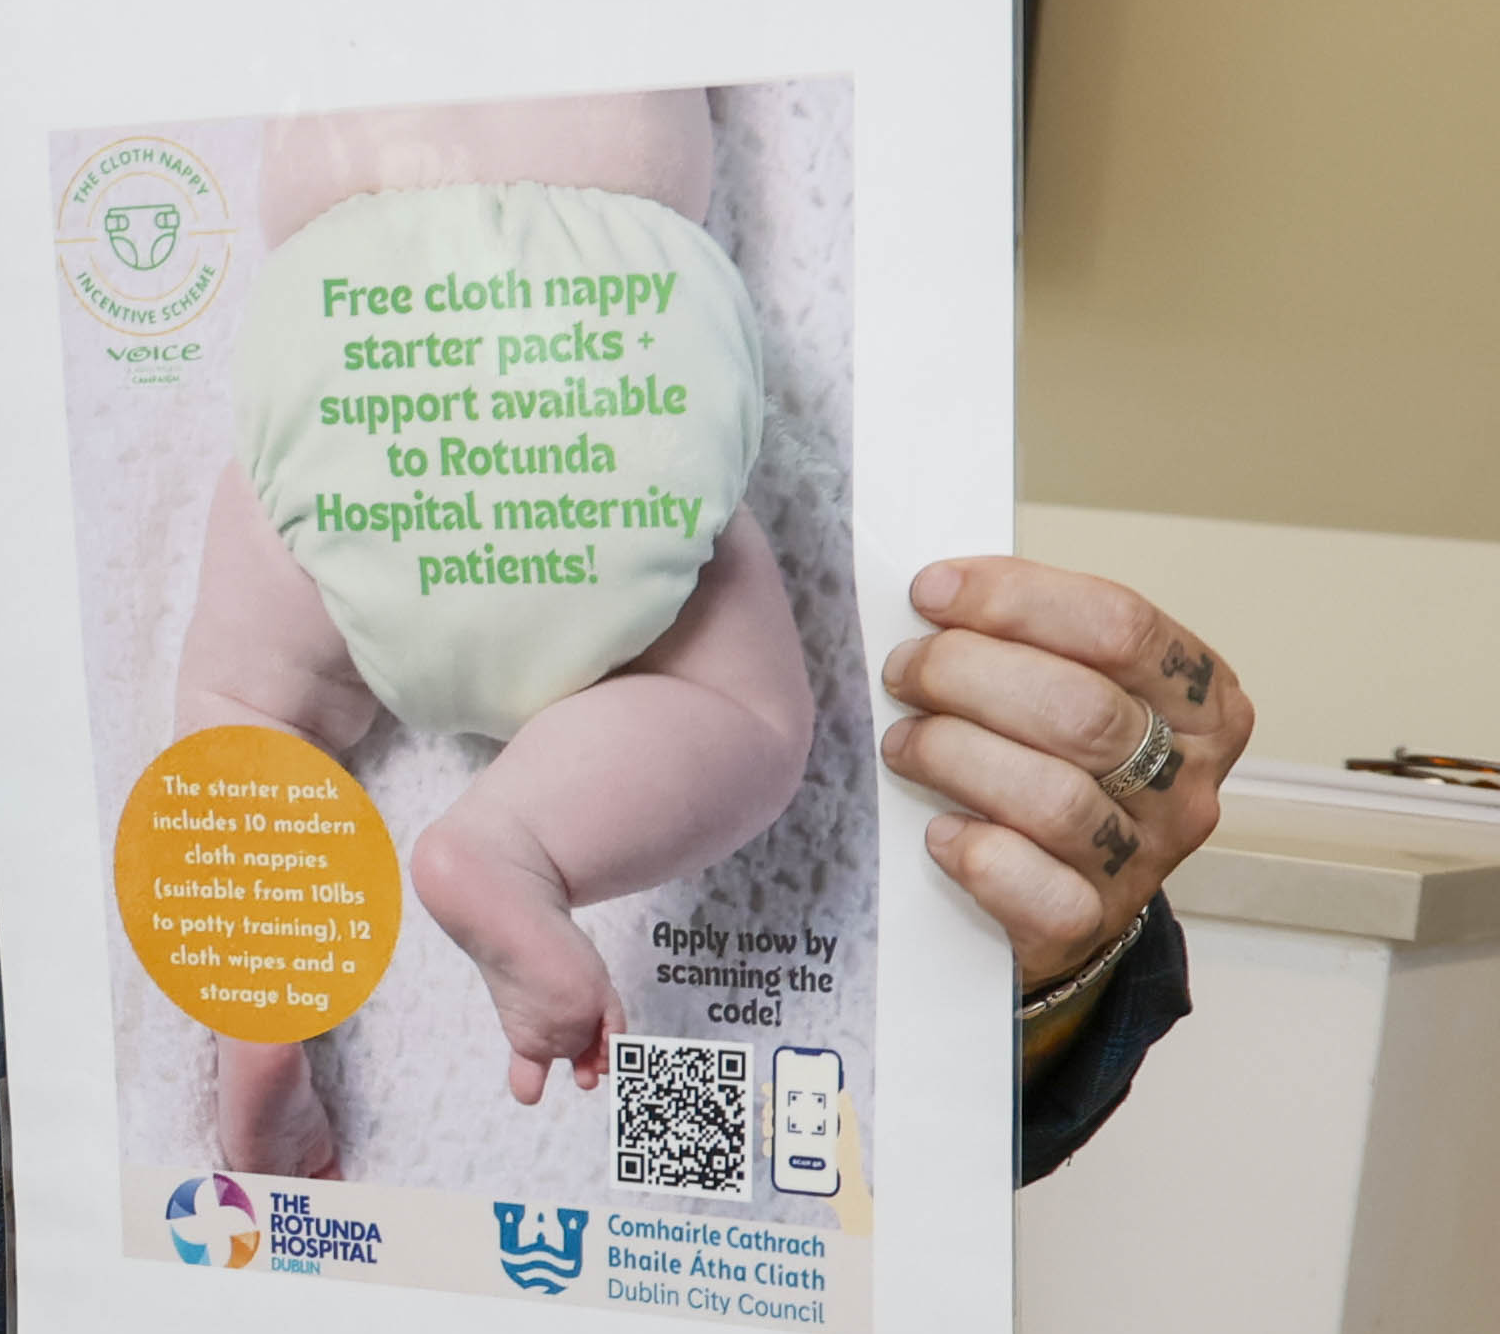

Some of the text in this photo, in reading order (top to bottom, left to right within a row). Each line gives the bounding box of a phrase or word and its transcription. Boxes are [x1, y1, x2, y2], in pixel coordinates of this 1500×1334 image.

[73, 149, 210, 204] THE CLOTH NAPPY
[76, 263, 215, 324] INCENTIVE SCHEME
[322, 270, 678, 317] Free cloth nappy
[343, 332, 483, 370] starter
[497, 321, 624, 375] packs
[319, 374, 687, 434] support available
[387, 432, 616, 477] to Rotunda
[315, 485, 702, 542] Hospital maternity
[418, 543, 598, 595] patients!
[162, 775, 339, 802] The starter pack
[152, 809, 355, 835] includes 10 modern
[184, 843, 328, 871] cloth nappies
[154, 877, 365, 904] (suitable from 10lbs
[152, 913, 371, 943] to potty training), 12
[653, 921, 837, 964] Apply now by
[170, 944, 356, 974] cloth wipes and a
[200, 983, 329, 1011] storage bag
[657, 961, 833, 997] scanning the
[708, 997, 782, 1027] code!
[270, 1192, 310, 1215] THE
[270, 1213, 382, 1244] ROTUNDA
[608, 1214, 825, 1258] Comhairle Cathrach
[271, 1234, 378, 1264] HOSPITAL
[271, 1257, 320, 1275] DUBLIN
[608, 1246, 825, 1291] Bhaile Átha Cliath
[608, 1278, 825, 1324] Dublin City Council
